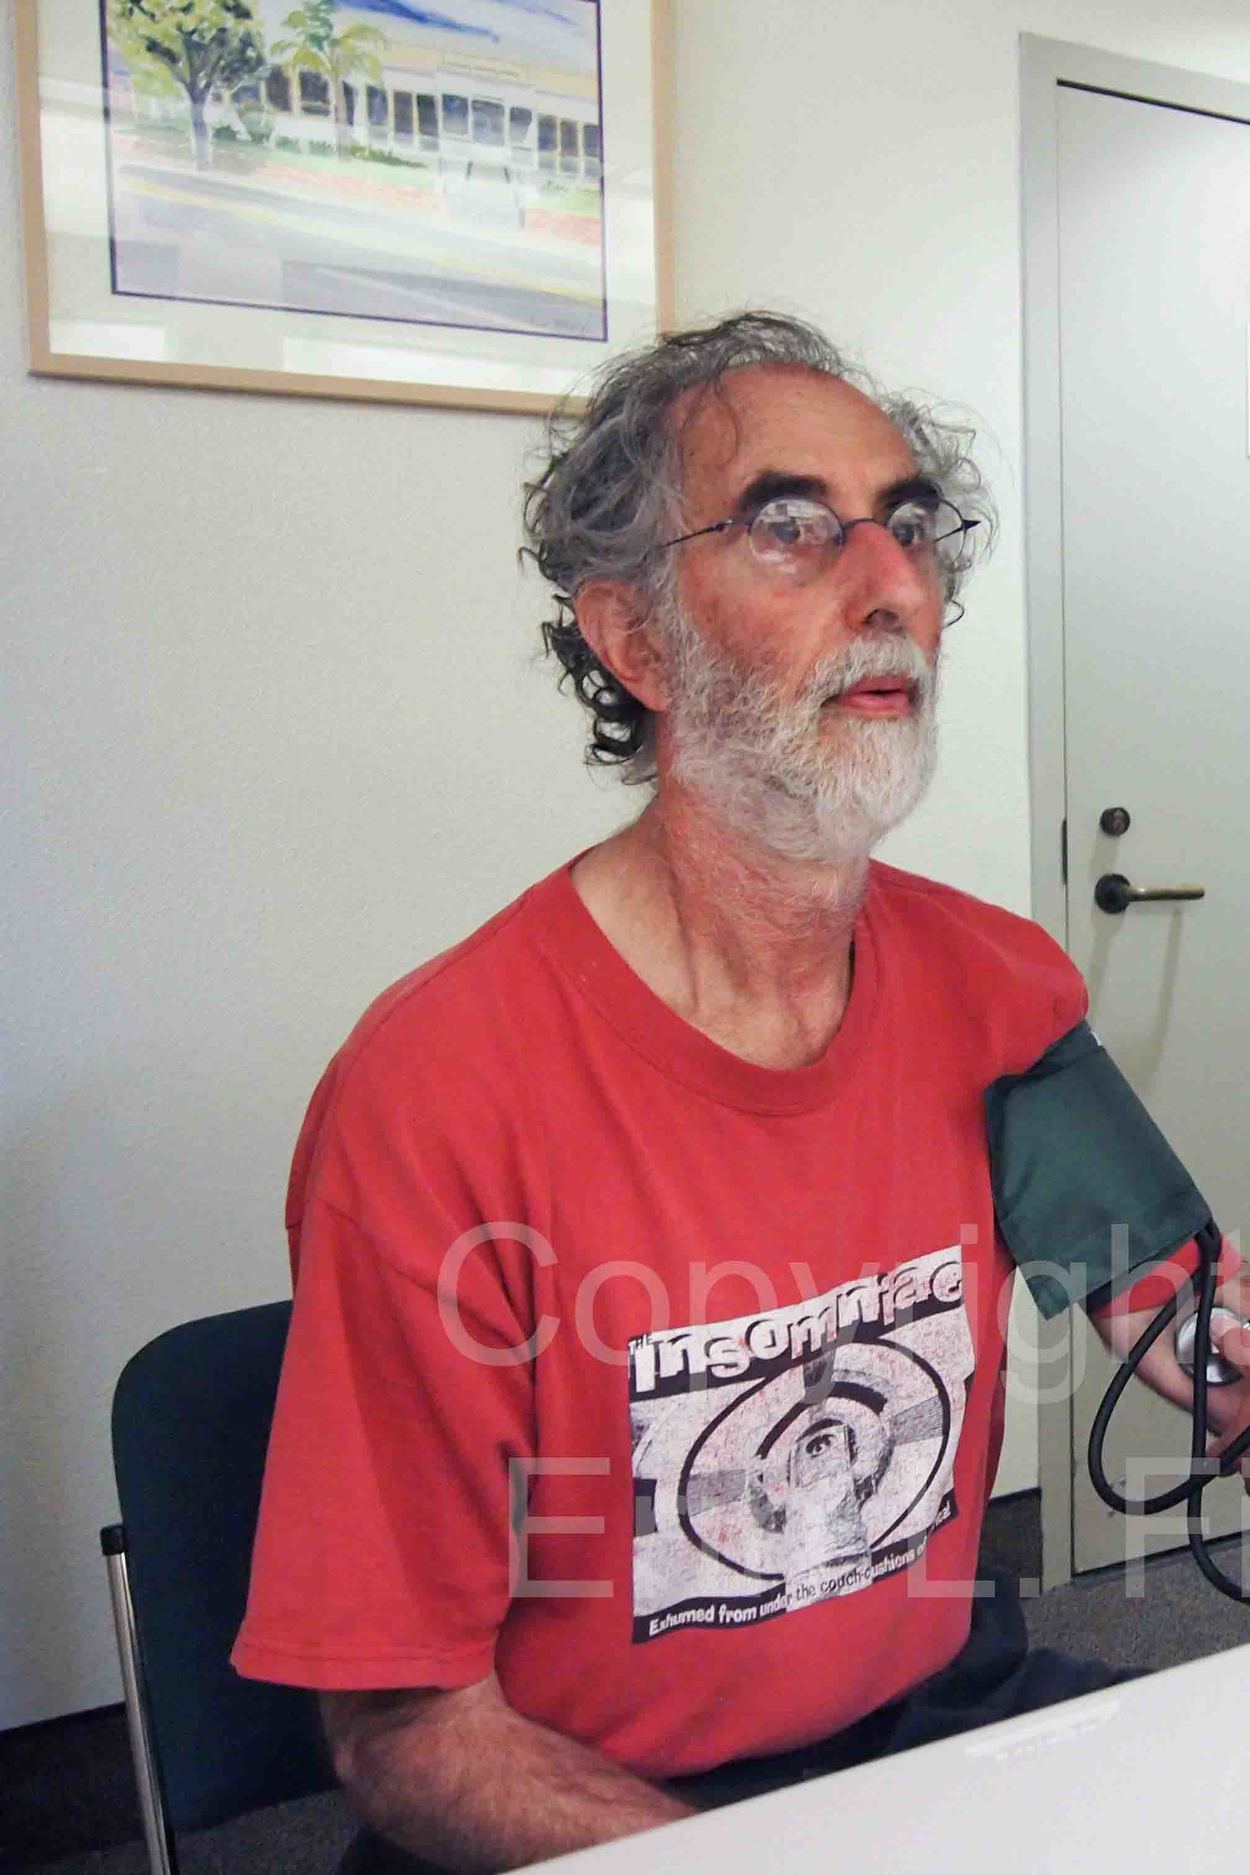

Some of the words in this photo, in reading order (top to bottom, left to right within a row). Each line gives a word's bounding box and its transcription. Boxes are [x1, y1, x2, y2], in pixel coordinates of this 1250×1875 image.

[634, 1261, 963, 1393] Insomniac
[649, 1604, 715, 1638] Exhumed
[719, 1603, 757, 1624] from
[796, 1583, 816, 1601] the
